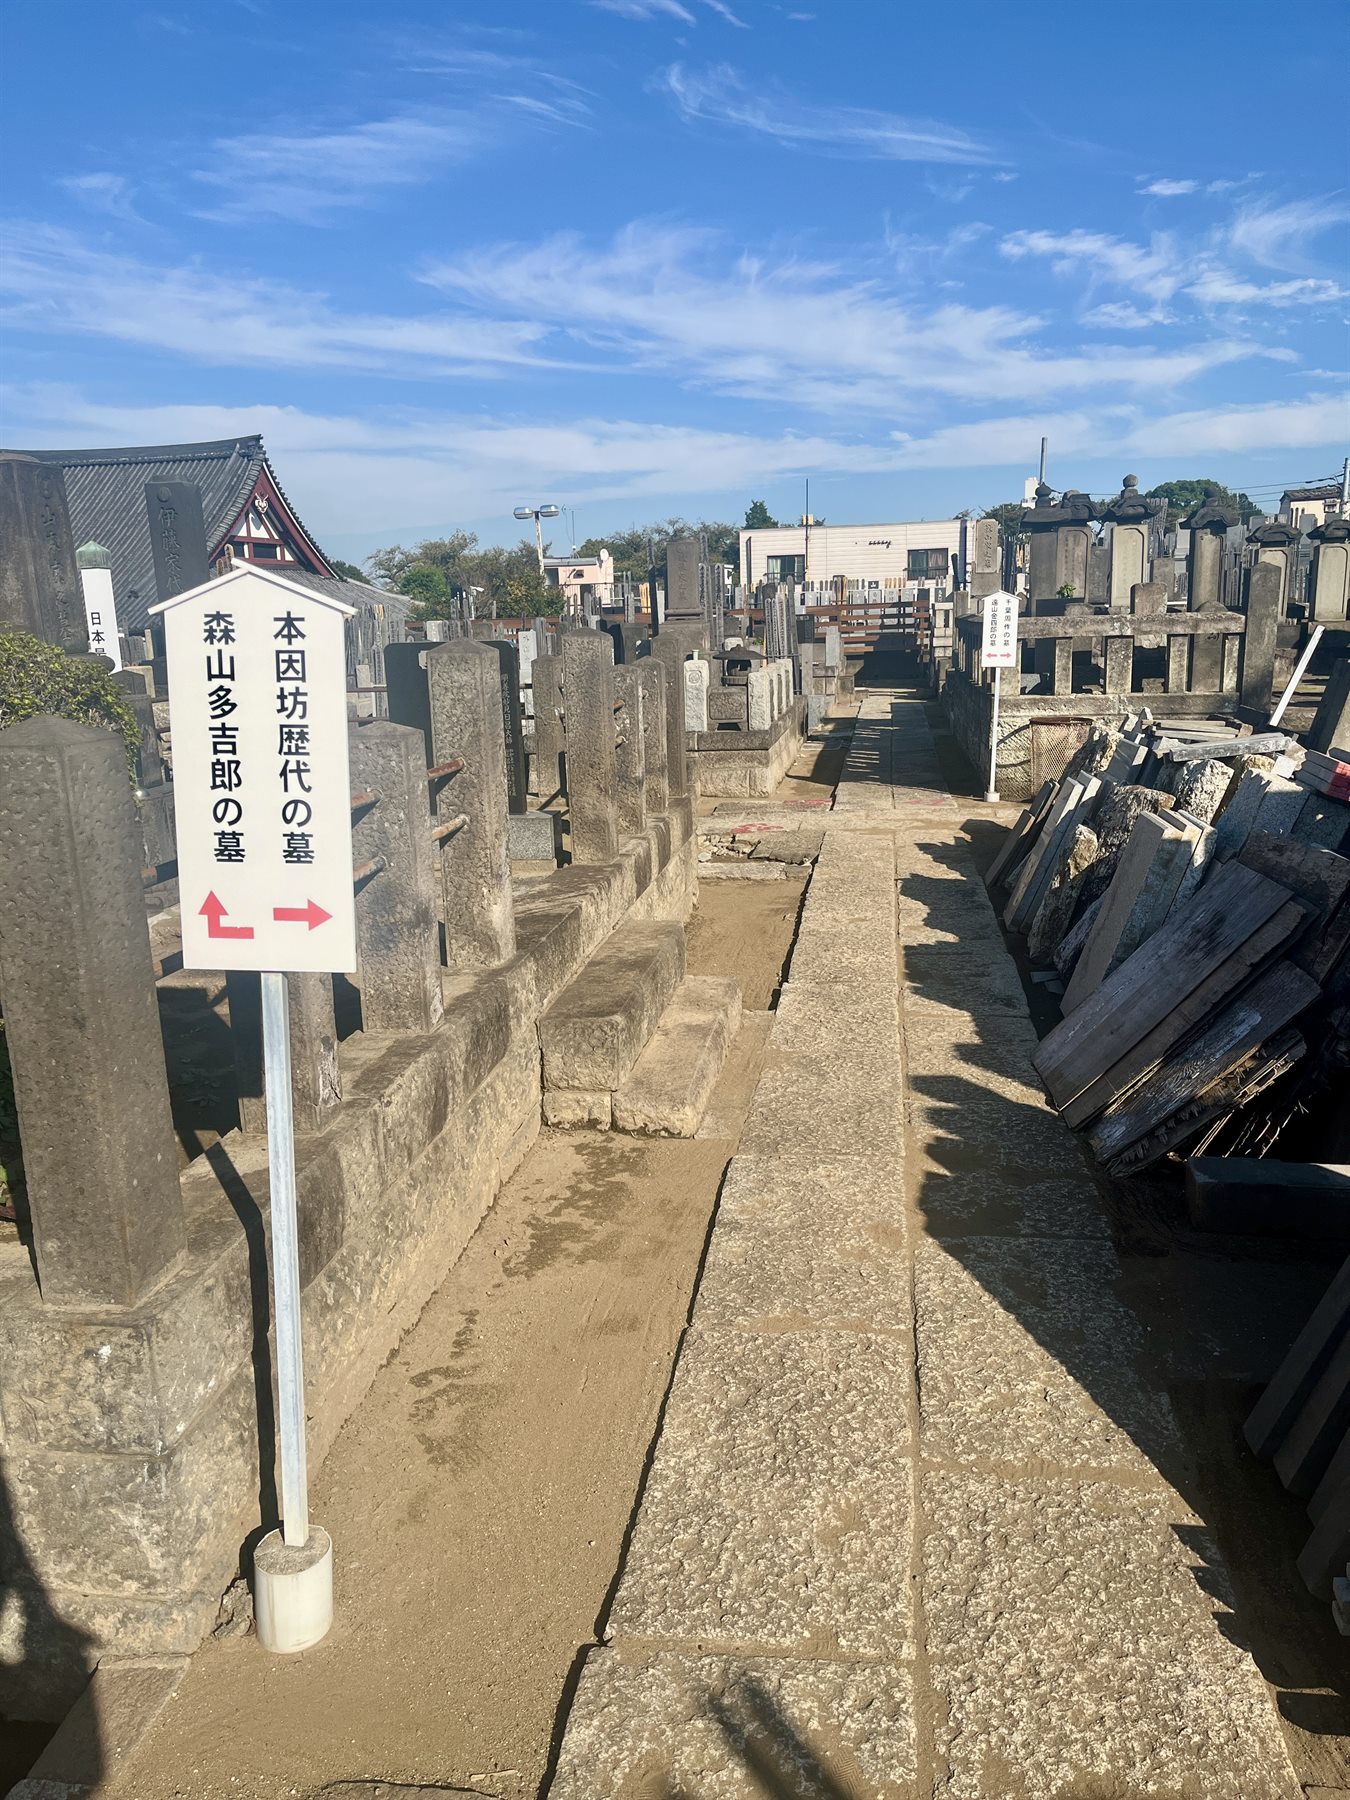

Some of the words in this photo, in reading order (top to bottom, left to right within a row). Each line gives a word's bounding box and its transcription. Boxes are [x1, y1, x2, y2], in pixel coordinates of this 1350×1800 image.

[203, 611, 245, 863] 森山多吉郎の墓
[273, 611, 314, 865] 本因坊歴代の墓
